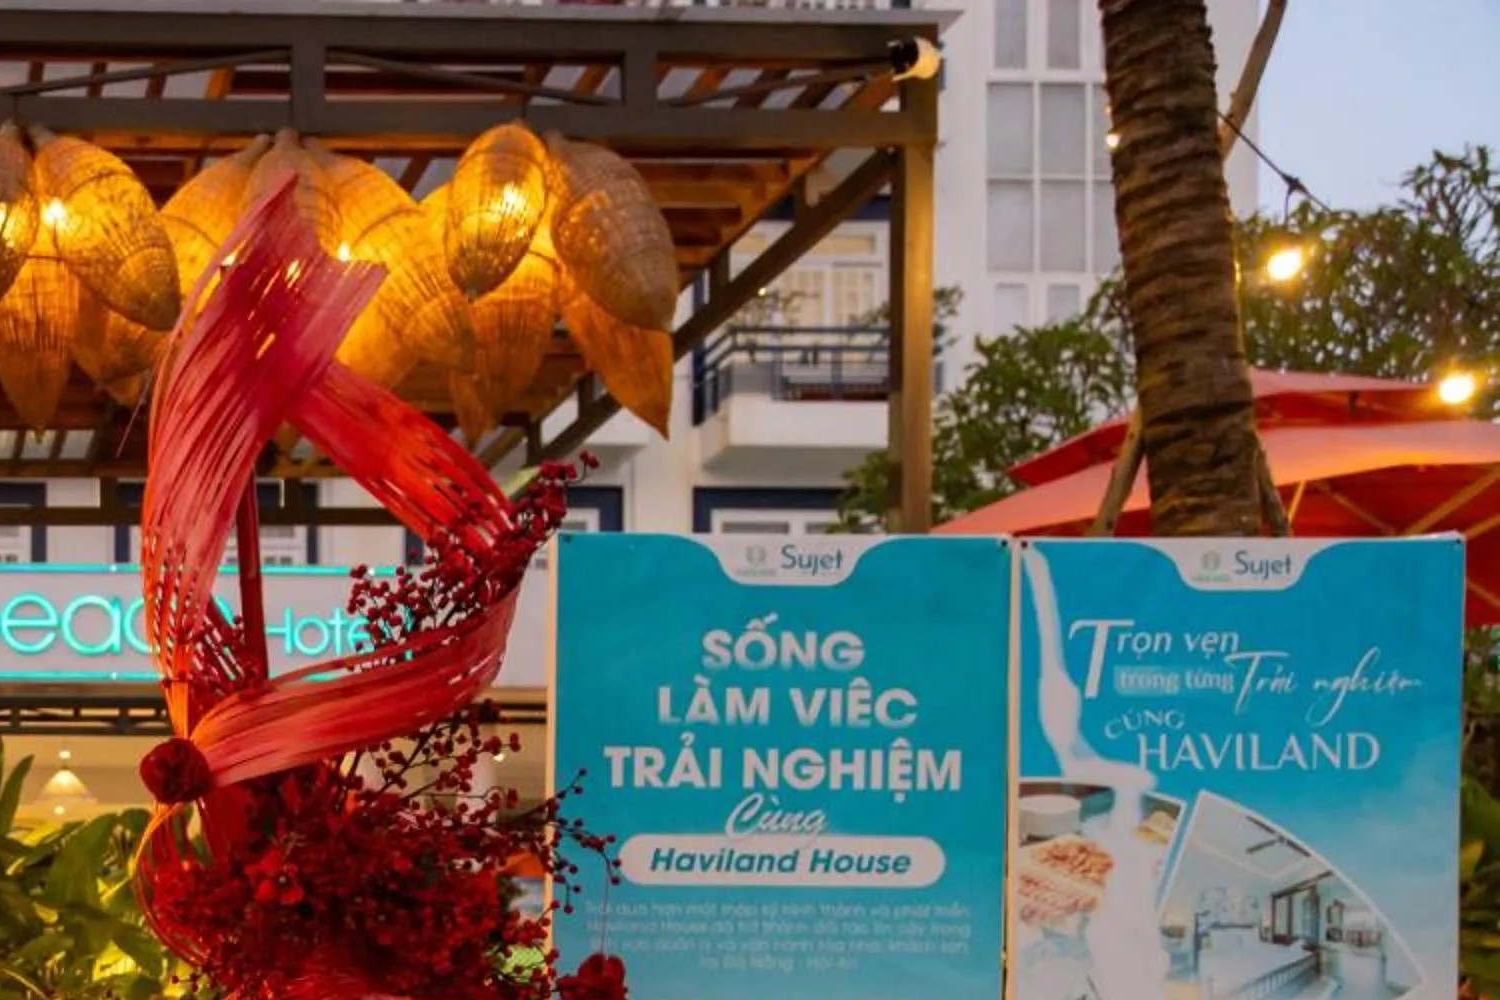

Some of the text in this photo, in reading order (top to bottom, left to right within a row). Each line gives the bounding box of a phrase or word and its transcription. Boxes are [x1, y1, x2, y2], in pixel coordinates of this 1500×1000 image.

[781, 543, 844, 577] Sujet
[1234, 550, 1292, 581] Sujet
[702, 612, 865, 669] SỐNG
[1069, 618, 1240, 699] Trọn vẹn
[657, 673, 771, 726] LÀM
[603, 731, 962, 804] TRẢI NGHIỆM
[1137, 731, 1382, 771] HAVILAND
[724, 792, 831, 843] Cùng
[650, 847, 912, 876] Haviland House
